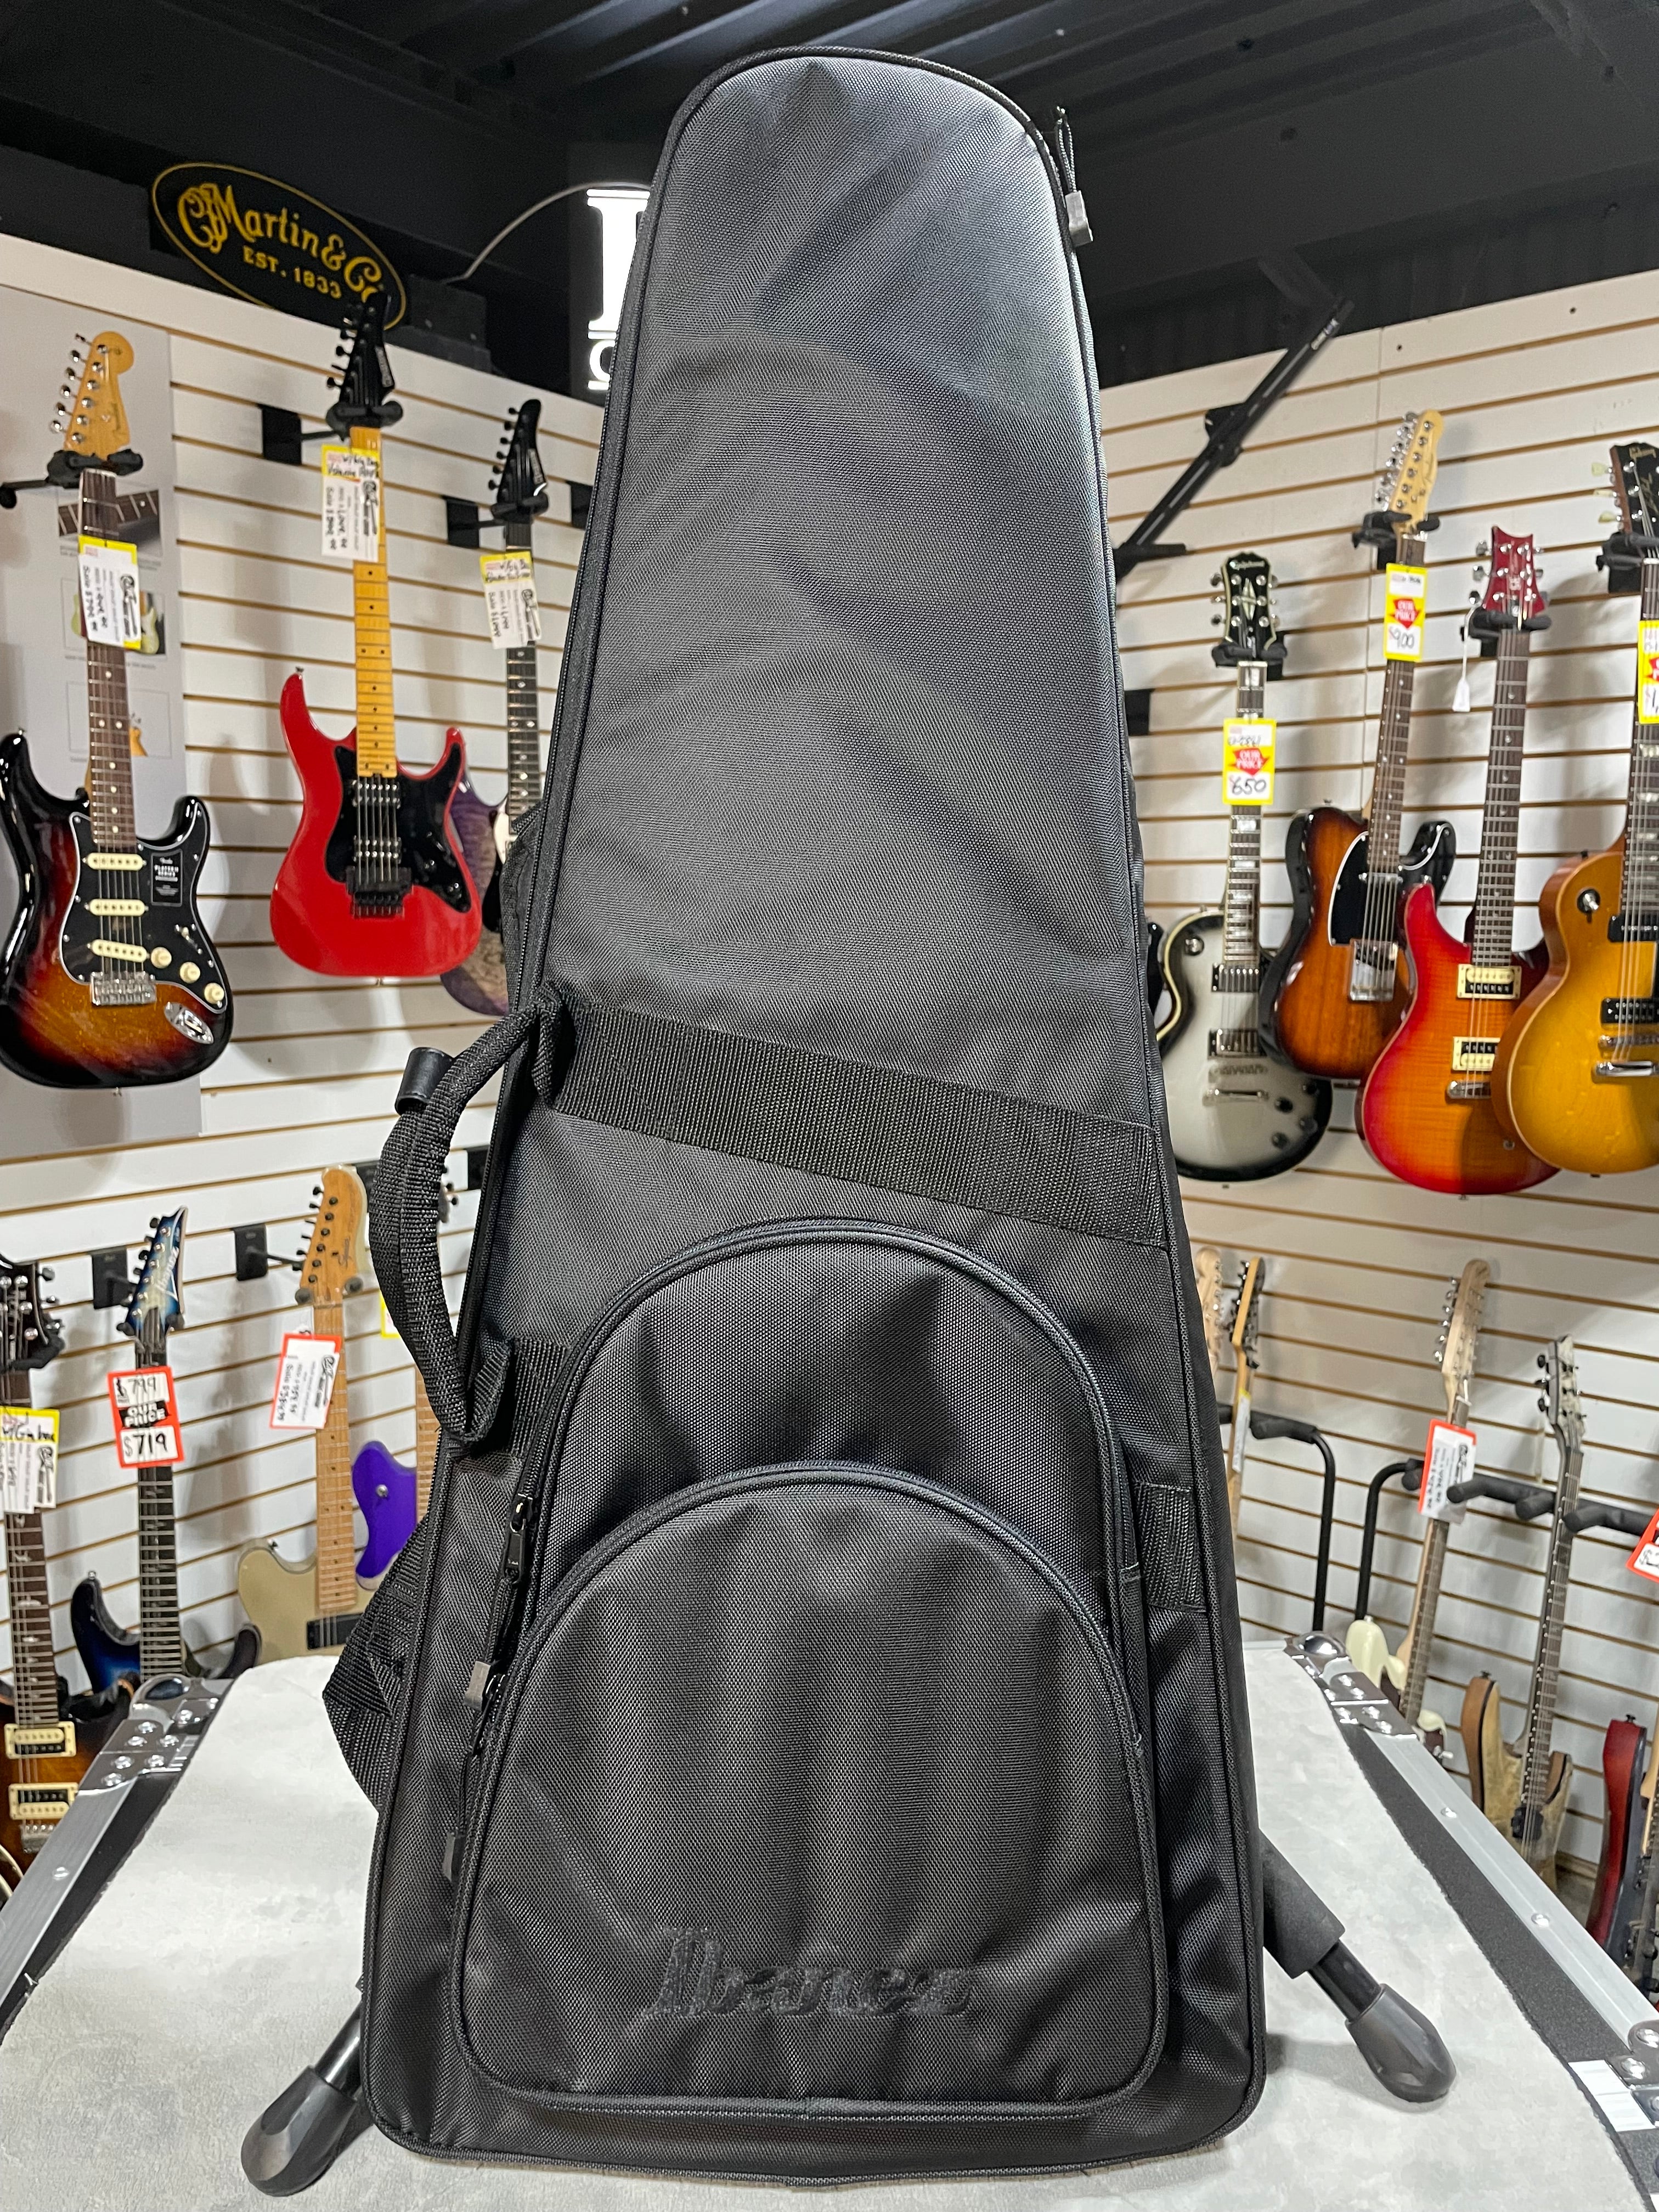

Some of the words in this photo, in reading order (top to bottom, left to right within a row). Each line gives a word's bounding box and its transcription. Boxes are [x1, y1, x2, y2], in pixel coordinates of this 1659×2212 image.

[243, 245, 287, 277] EST.
[294, 267, 342, 299] 1833
[124, 1408, 166, 1427] PRICE
[127, 1402, 157, 1421] OUR
[644, 1926, 971, 2017] Ibanez
